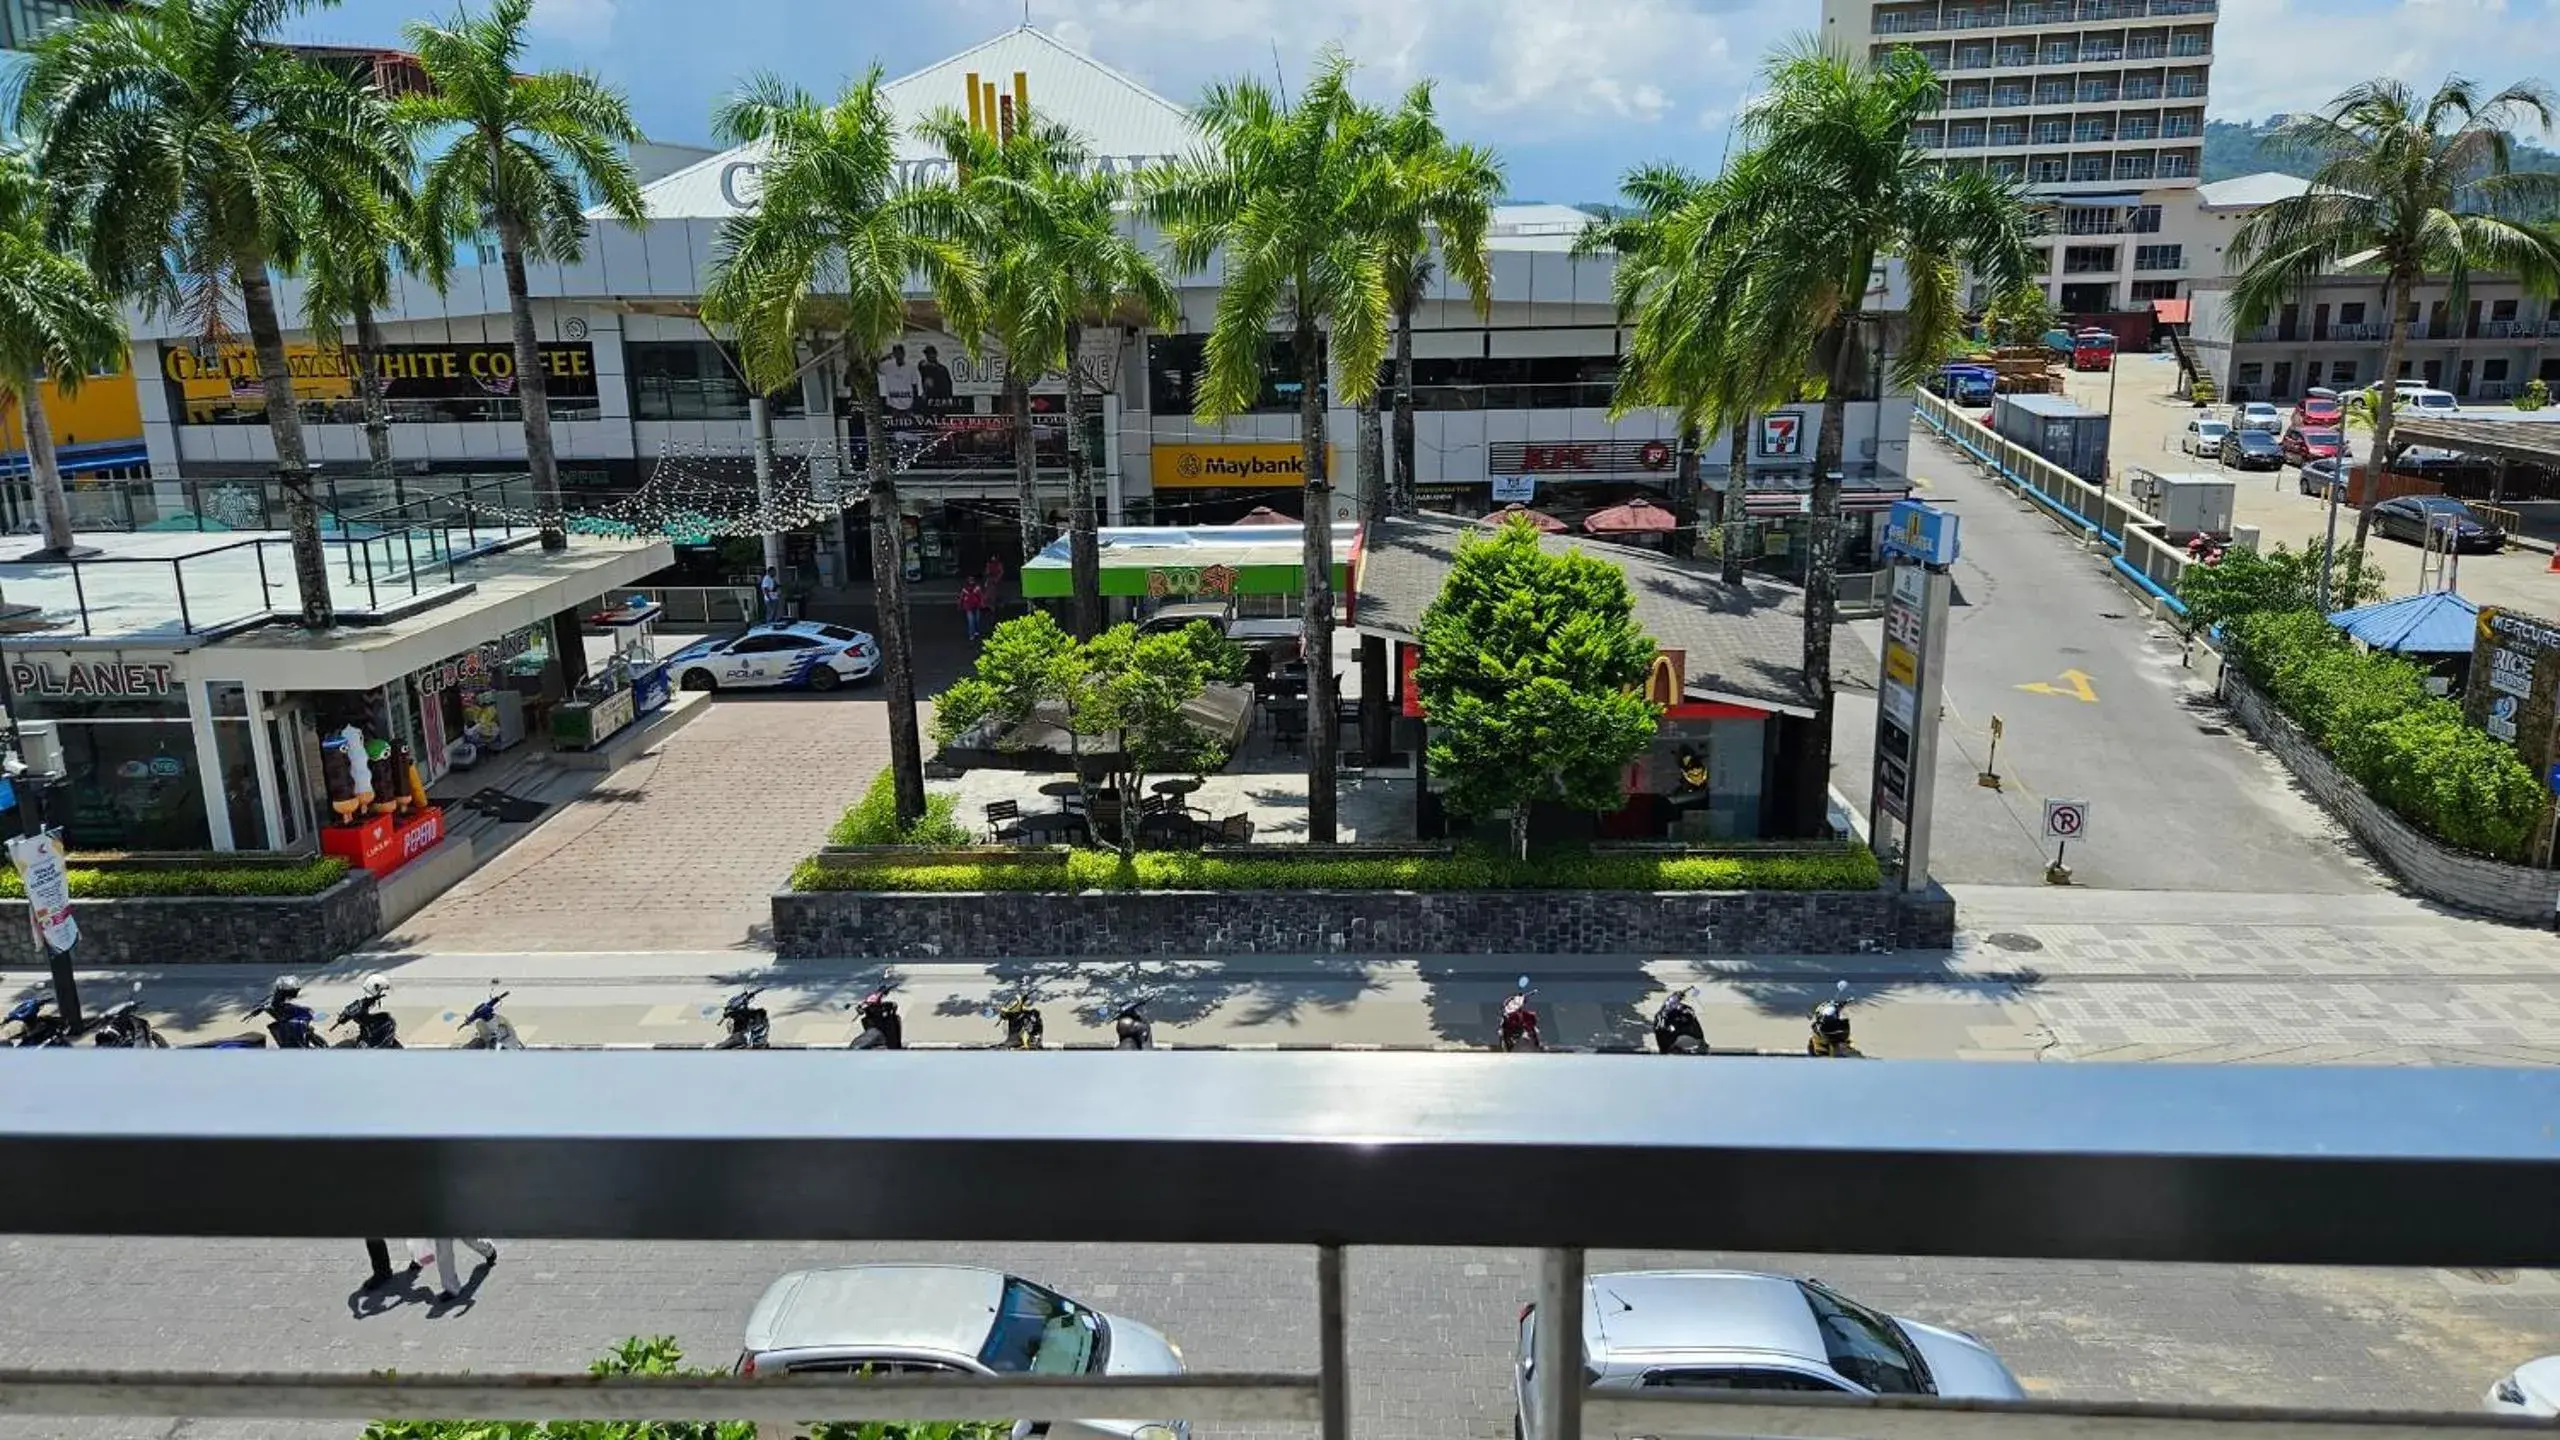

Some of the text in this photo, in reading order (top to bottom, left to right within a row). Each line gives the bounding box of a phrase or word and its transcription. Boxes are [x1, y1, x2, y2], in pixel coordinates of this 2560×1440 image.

[1769, 420, 1795, 452] 7
[1206, 455, 1305, 478] Maybank
[1146, 565, 1240, 597] BOOST
[11, 662, 171, 696] PLANET
